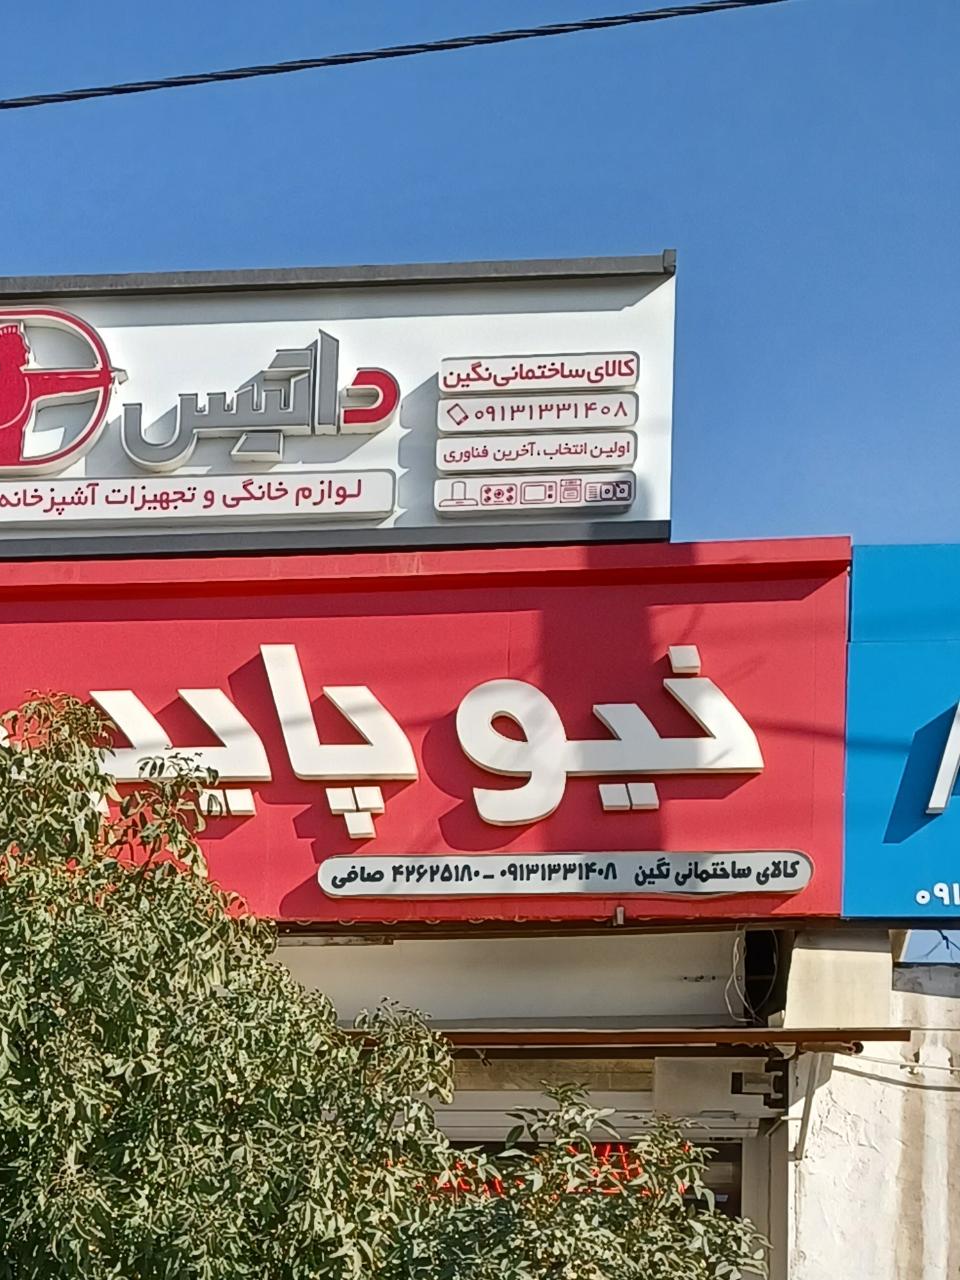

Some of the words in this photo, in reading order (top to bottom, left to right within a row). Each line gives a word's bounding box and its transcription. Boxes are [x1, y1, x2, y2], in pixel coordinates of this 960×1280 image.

[443, 361, 492, 388] نگین
[493, 362, 585, 386] ساختمانی
[587, 359, 635, 383] کالای
[475, 401, 628, 421] ۰۹۱۳۱۳۳۱۴۰۸
[443, 445, 489, 463] فناوری
[493, 442, 535, 461] آخرین
[590, 441, 630, 458] اولین
[104, 485, 197, 511] تجهیزات
[202, 489, 215, 508] و
[222, 479, 288, 508] خانگی
[295, 479, 362, 506] لوازم
[456, 645, 764, 826] نیو
[331, 865, 385, 889] صافی
[501, 862, 617, 882] ۰۹۱۳۱۳۳۱۴۰۸
[634, 858, 670, 885] نگین
[674, 861, 752, 886] ساختمانی
[756, 860, 800, 885] کالای
